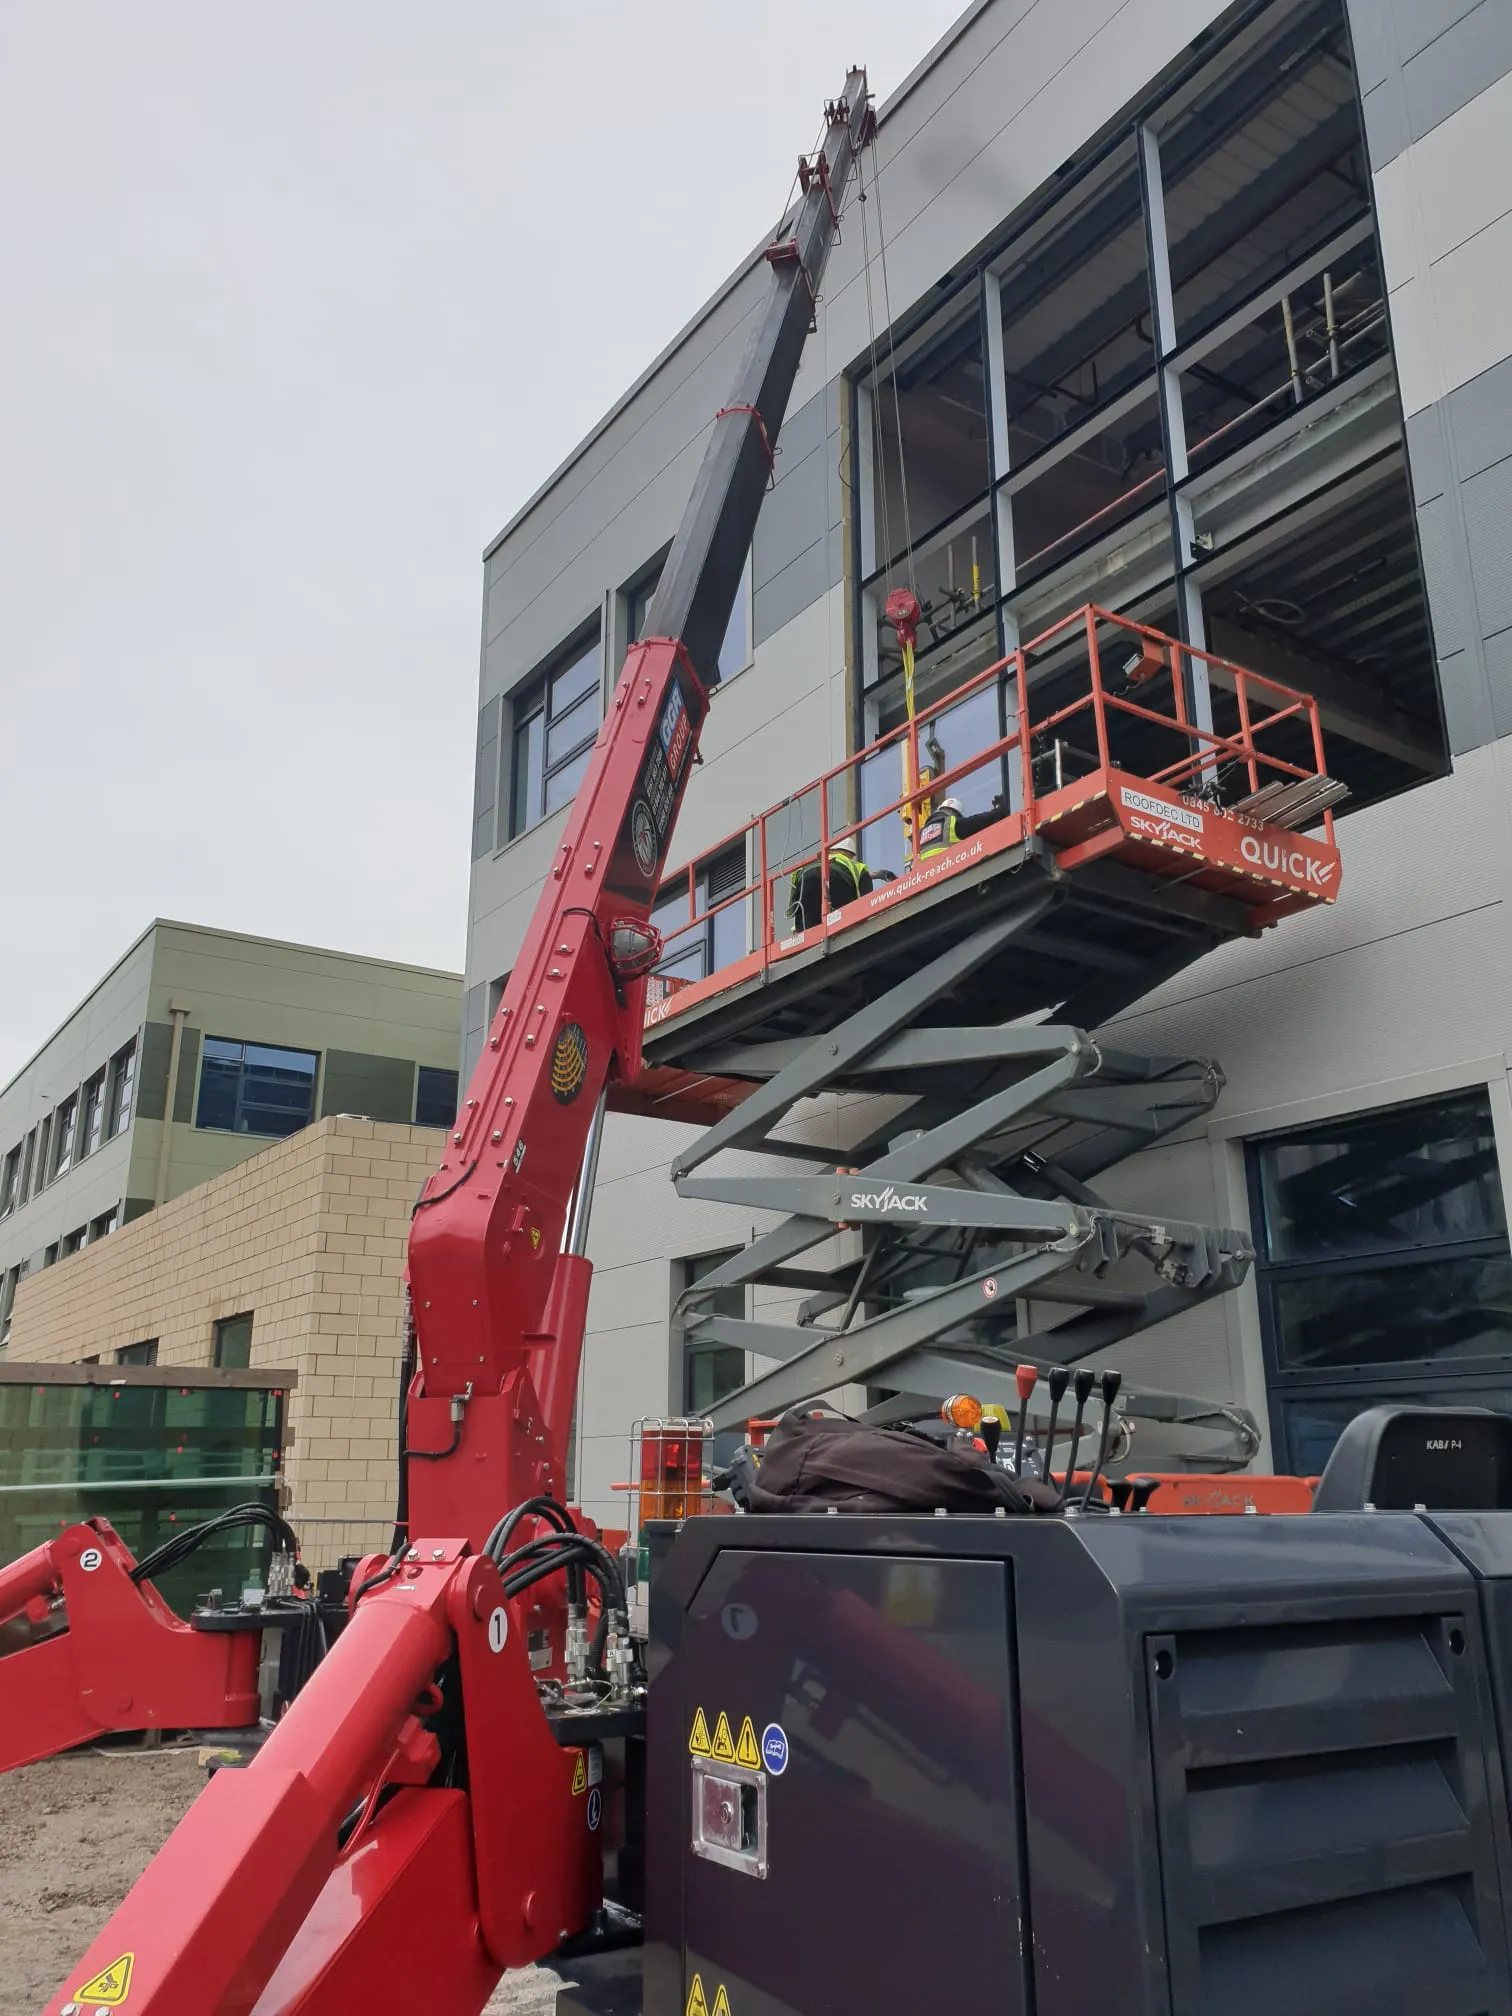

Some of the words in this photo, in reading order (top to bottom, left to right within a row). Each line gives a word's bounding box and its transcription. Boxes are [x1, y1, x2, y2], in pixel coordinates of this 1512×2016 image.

[670, 714, 687, 769] GROUP
[1124, 791, 1179, 821] ROOFDEC
[1181, 813, 1200, 828] LTD
[1182, 795, 1210, 812] 0845
[1238, 813, 1264, 831] 2733
[1130, 815, 1203, 850] SKYJACK
[870, 840, 983, 907] www.quick-reach.co.uk
[1240, 836, 1323, 885] QUICK
[850, 1185, 929, 1213] SKYJACK
[83, 1552, 99, 1568] 2
